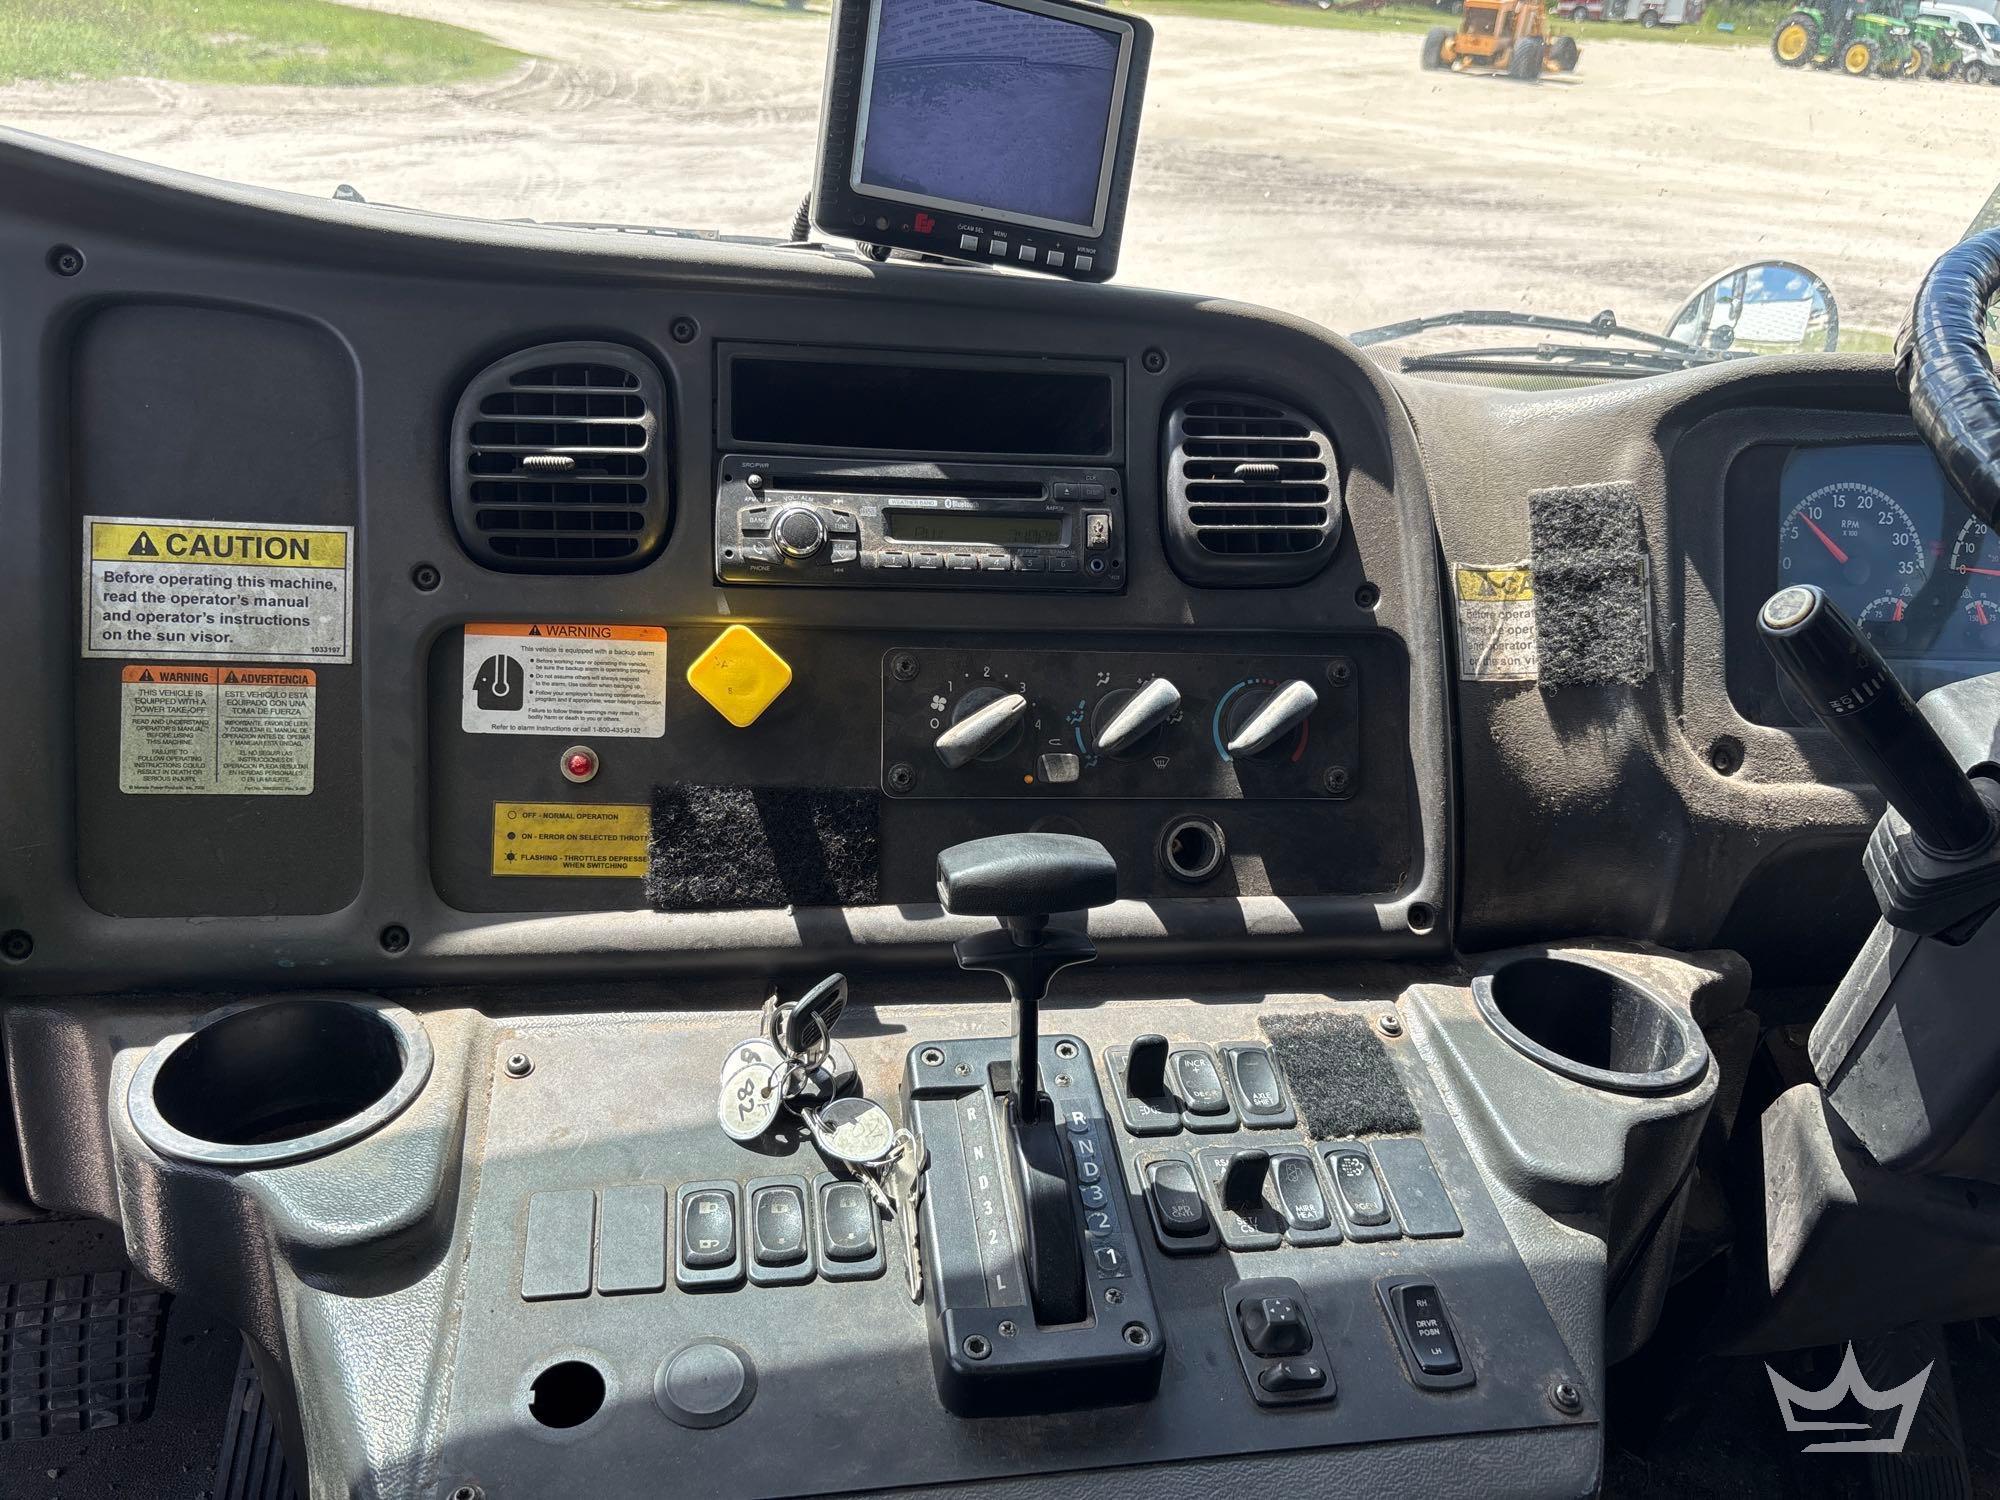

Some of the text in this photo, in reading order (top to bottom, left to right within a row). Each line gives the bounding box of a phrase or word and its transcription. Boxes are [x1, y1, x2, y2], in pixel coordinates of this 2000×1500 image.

[993, 230, 1008, 238] MENU
[1832, 495, 1846, 508] 15
[1857, 496, 1873, 509] 20
[1808, 507, 1822, 520] 10
[1878, 512, 1894, 525] 25
[1841, 520, 1860, 529] RPM
[1974, 524, 1988, 535] 20
[1790, 527, 1799, 540] 5
[1892, 533, 1909, 546] 30
[166, 533, 310, 560] CAUTION
[1965, 543, 1975, 554] 10
[1782, 558, 1792, 569] 0
[1898, 561, 1914, 575] 35
[104, 571, 337, 592] Before operating this machine,
[103, 591, 309, 608] read the operator’s manual
[103, 610, 310, 627] and operator’s instructions
[102, 629, 233, 643] on the sun visor.
[547, 625, 612, 638] WARNING
[565, 647, 593, 655] equipped
[614, 648, 636, 657] backup
[1501, 657, 1521, 666] sun
[160, 672, 209, 683] WARNING
[983, 666, 991, 678] 2
[240, 674, 309, 685] ADVERTENCIA
[139, 689, 158, 697] THIS
[159, 689, 194, 697] VEHICLE
[947, 681, 953, 692] 1
[1019, 681, 1026, 693] 3
[167, 706, 206, 714] TAKE-OFF
[226, 699, 268, 707] EQUIPADO
[289, 700, 307, 708] UNA
[1035, 718, 1042, 731] 4
[543, 812, 575, 820] NORMAL
[1184, 1059, 1206, 1067] INCR
[1253, 1092, 1272, 1100] AXLE
[967, 1107, 977, 1121] R
[1072, 1111, 1086, 1125] R
[1079, 1139, 1094, 1154] N
[974, 1146, 984, 1161] N
[1084, 1162, 1099, 1177] D
[979, 1175, 989, 1190] D
[1093, 1185, 1103, 1201] 3
[984, 1200, 993, 1215] 3
[1098, 1212, 1111, 1229] 2
[1297, 1211, 1318, 1219] HEAT
[1240, 1225, 1260, 1233] CST
[989, 1230, 998, 1245] 2
[1106, 1249, 1118, 1264] 1
[996, 1275, 1007, 1290] L
[1416, 1299, 1428, 1307] RH
[1416, 1319, 1438, 1328] DRVR
[1419, 1328, 1440, 1337] POSN
[1431, 1347, 1442, 1355] LH
